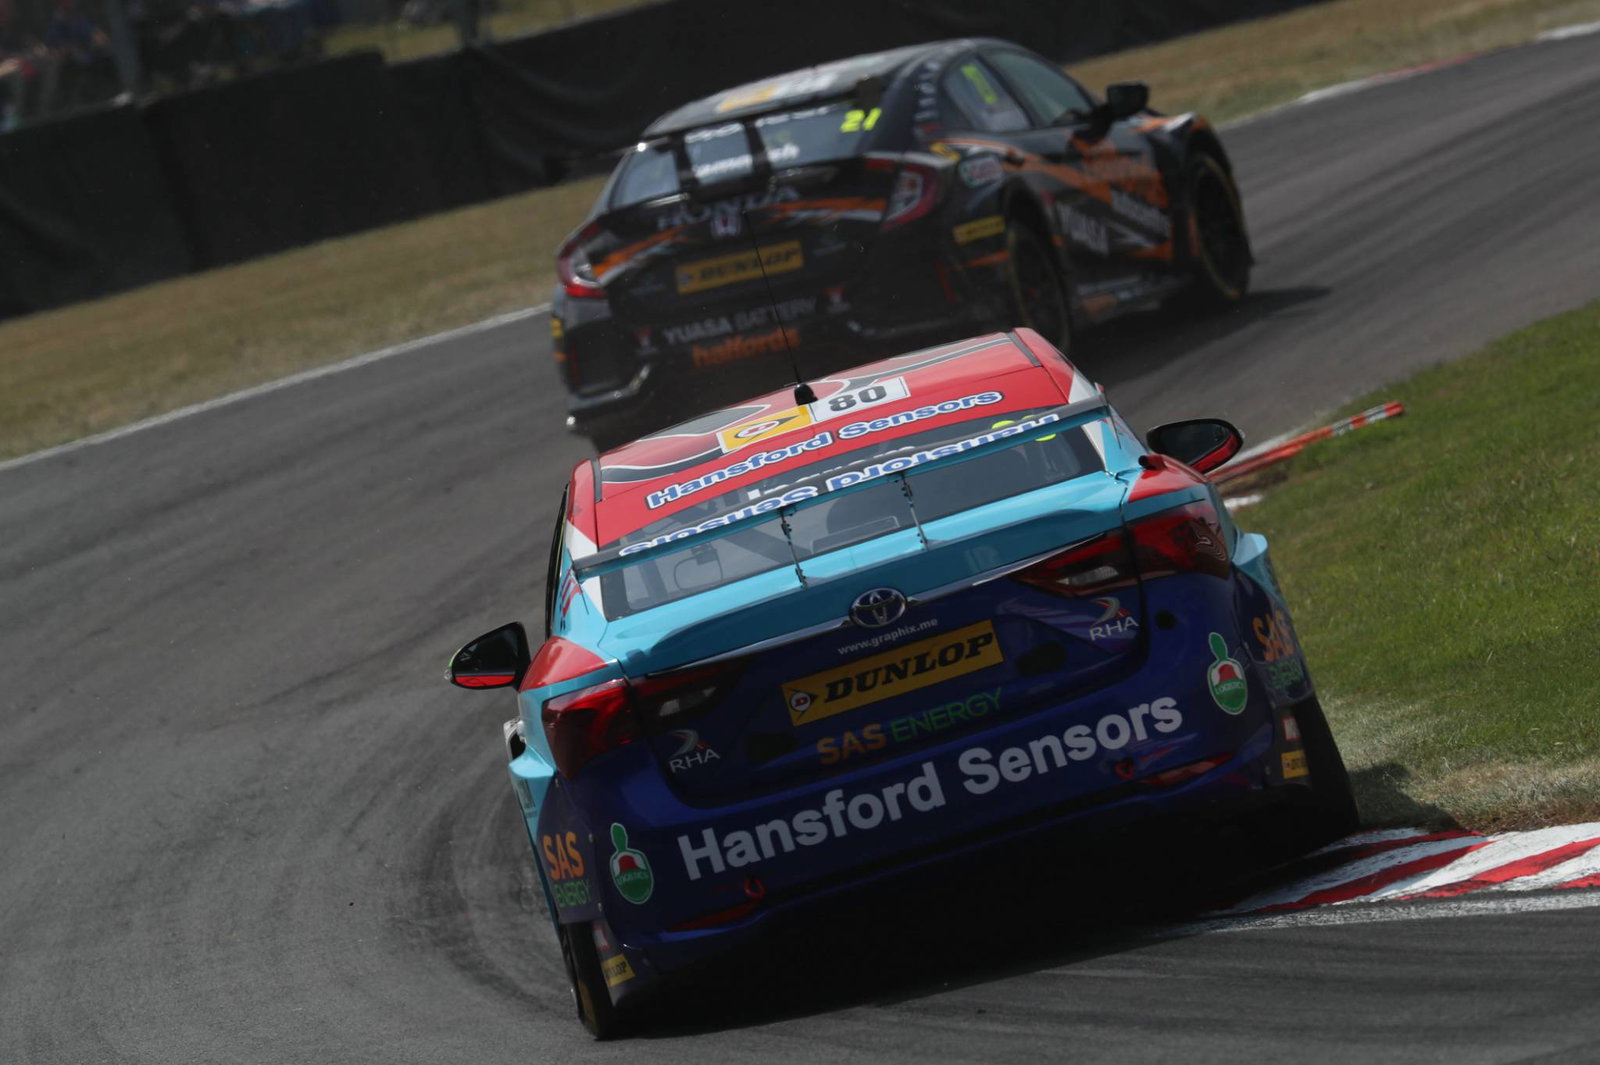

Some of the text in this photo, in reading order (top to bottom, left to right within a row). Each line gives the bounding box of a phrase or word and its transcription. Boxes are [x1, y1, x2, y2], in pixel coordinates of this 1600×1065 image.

[662, 316, 733, 346] YUASA
[828, 385, 887, 412] 80
[646, 432, 833, 510] Hansford
[837, 390, 1004, 441] Sensors
[837, 617, 939, 656] www.graphix.me
[1089, 616, 1140, 641] RHA
[823, 630, 993, 703] DUNLOP
[816, 689, 1001, 766] SAS ENERGY
[669, 748, 721, 773] RHA
[677, 696, 1184, 881] Hansford Sensors
[543, 831, 585, 880] SAS
